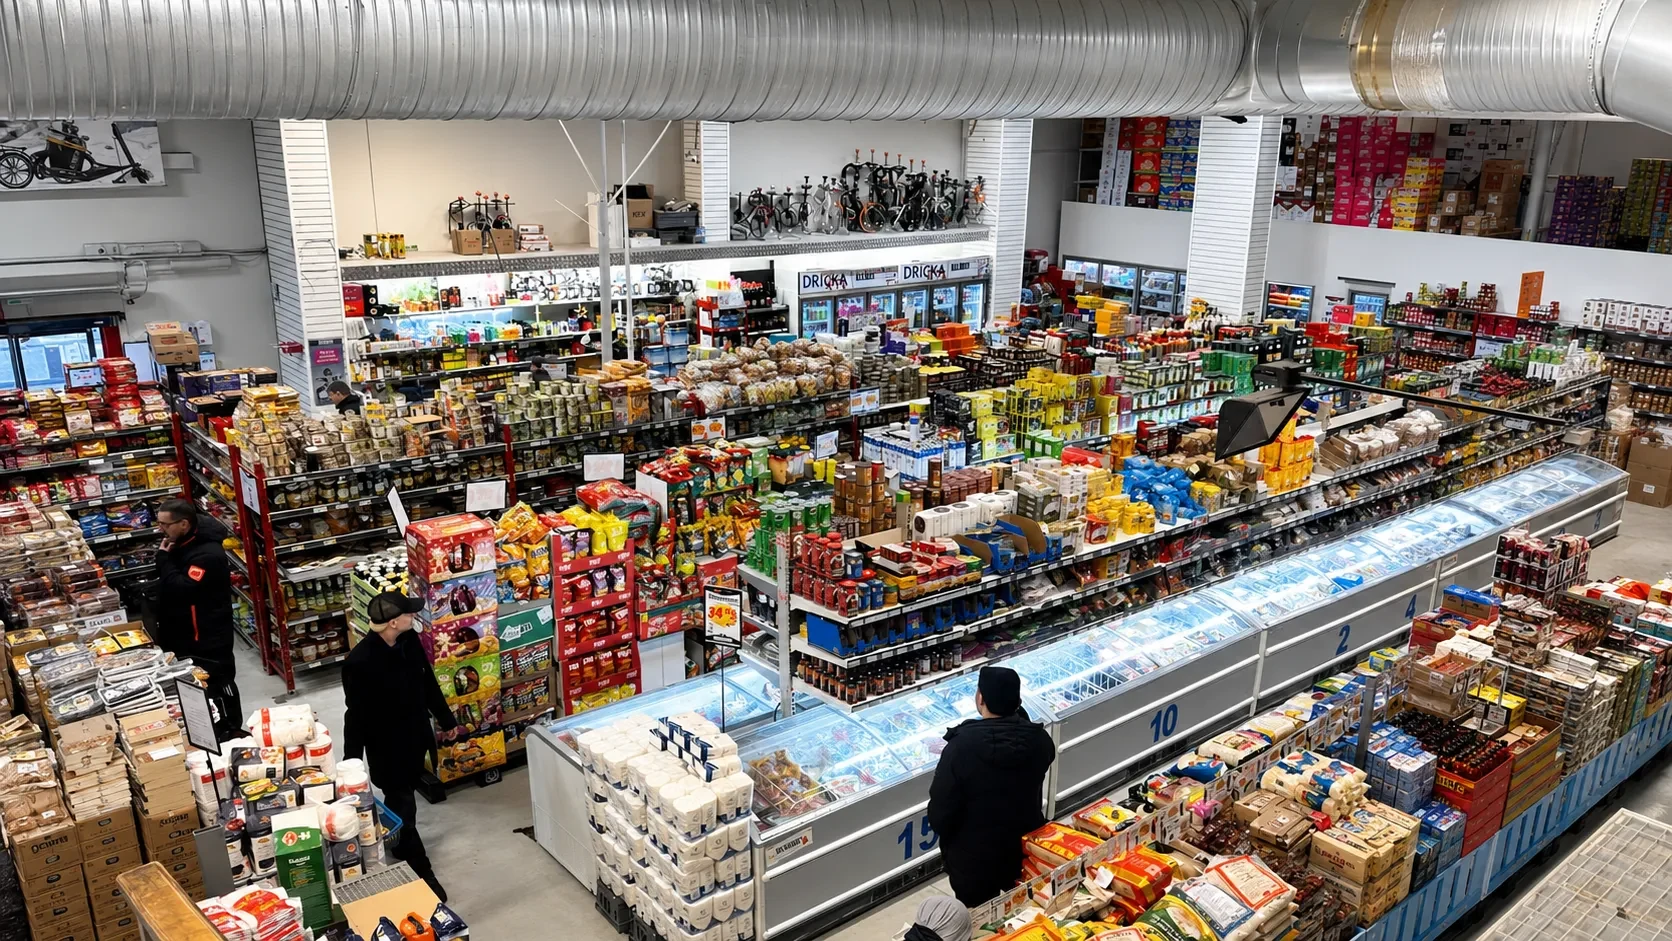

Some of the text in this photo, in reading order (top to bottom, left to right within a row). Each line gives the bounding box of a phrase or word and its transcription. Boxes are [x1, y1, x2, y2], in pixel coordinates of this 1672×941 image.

[1405, 594, 1417, 619] 4
[1335, 624, 1351, 655] 2
[1150, 703, 1178, 743] 10
[897, 815, 940, 860] 15
